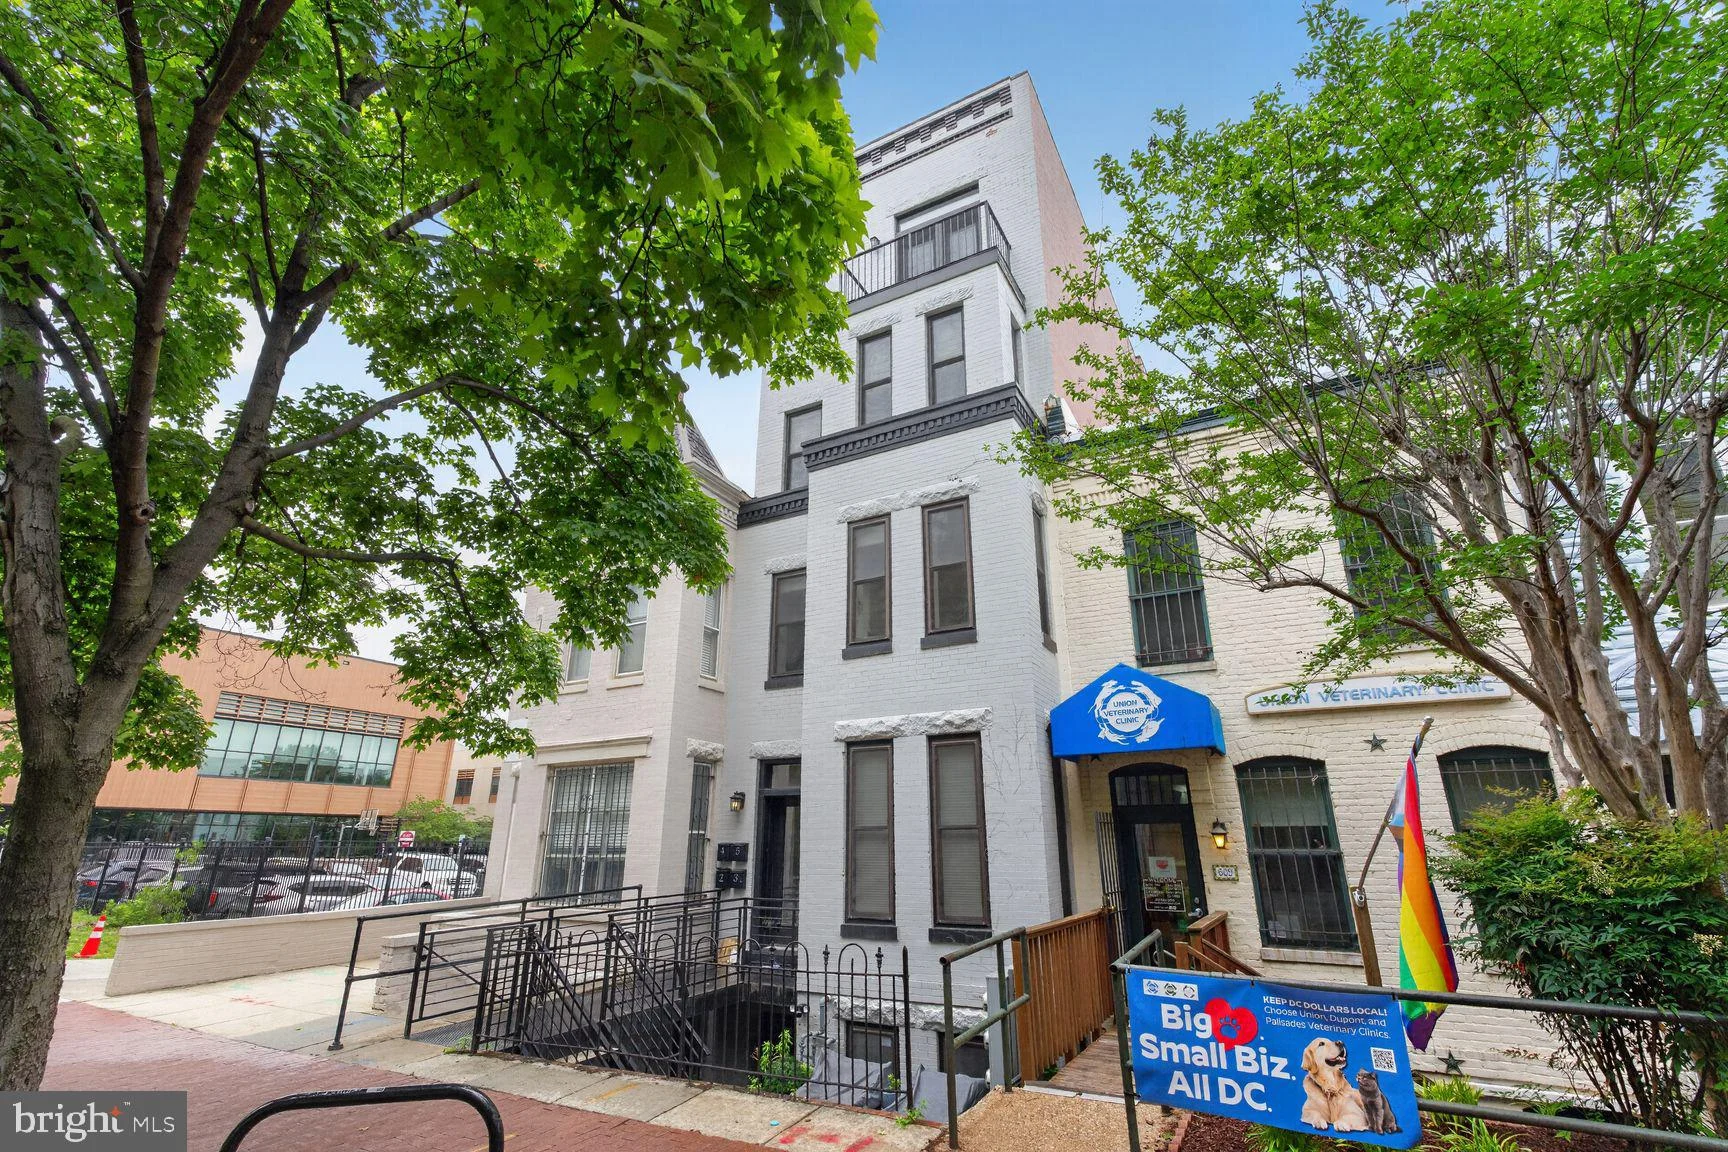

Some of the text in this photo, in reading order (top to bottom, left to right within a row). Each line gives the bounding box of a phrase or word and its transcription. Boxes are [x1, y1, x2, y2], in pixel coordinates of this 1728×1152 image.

[1112, 699, 1138, 708] UNION
[1318, 685, 1422, 703] VETERINARY
[1103, 706, 1149, 717] VETERINARY
[1115, 716, 1140, 725] CLINIC
[1262, 995, 1388, 1016] KEEP DC DOLLARS LOCAL!
[1264, 1005, 1387, 1027] Choose Union, Dupont, and
[1160, 1003, 1213, 1039] Big
[1265, 1016, 1391, 1039] Palisades Veterinary Clinics.
[1139, 1032, 1297, 1081] Small Biz.
[1167, 1070, 1273, 1113] All DC.
